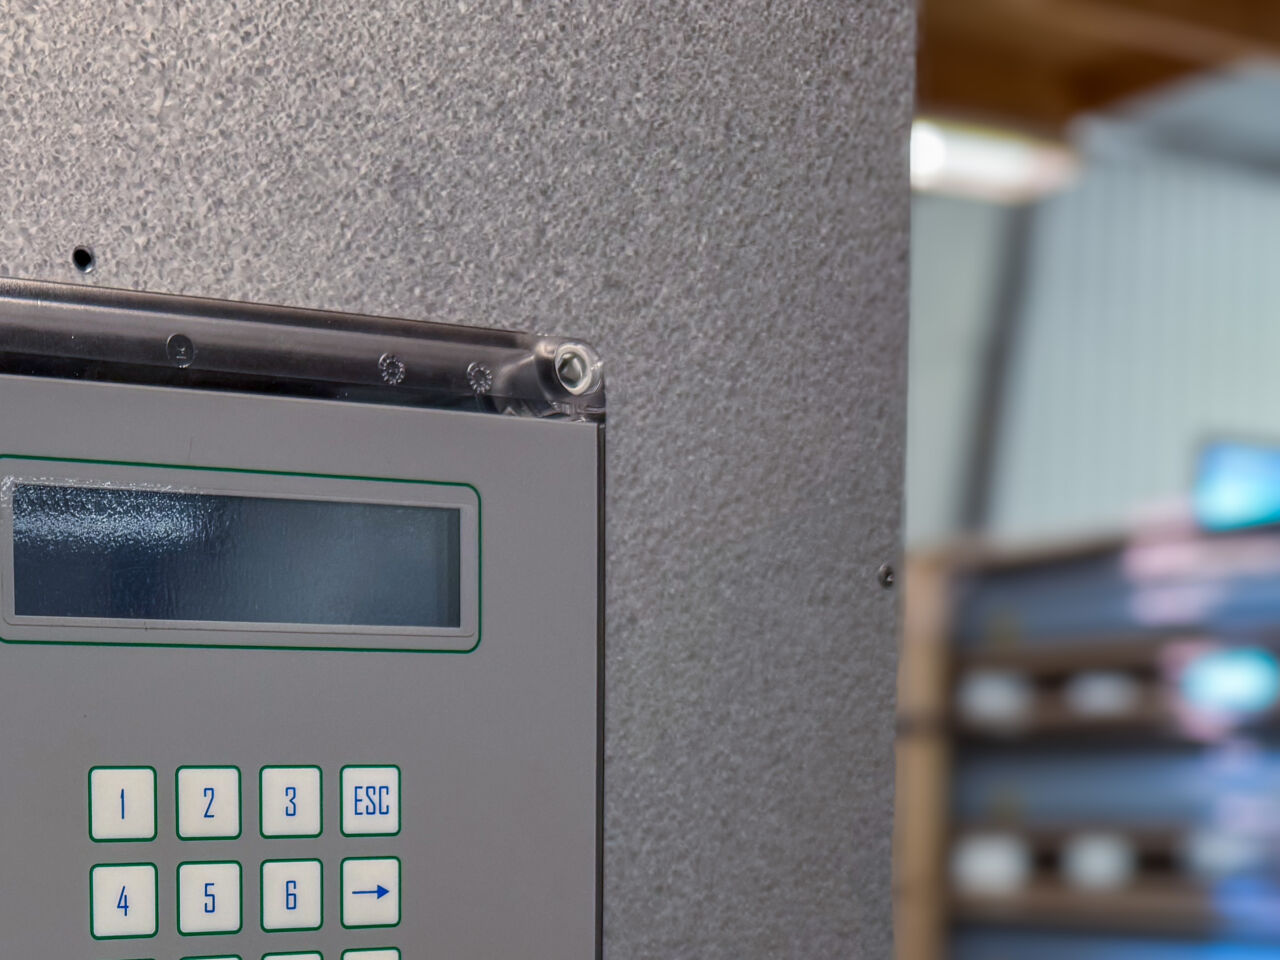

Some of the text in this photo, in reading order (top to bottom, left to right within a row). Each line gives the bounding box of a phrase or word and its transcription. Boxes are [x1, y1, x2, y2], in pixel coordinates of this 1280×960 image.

[119, 787, 126, 820] 1
[203, 787, 216, 819] 2
[284, 786, 297, 817] 3
[353, 784, 390, 817] ESC
[116, 885, 130, 916] 4
[203, 882, 216, 914] 5
[285, 880, 298, 911] 6
